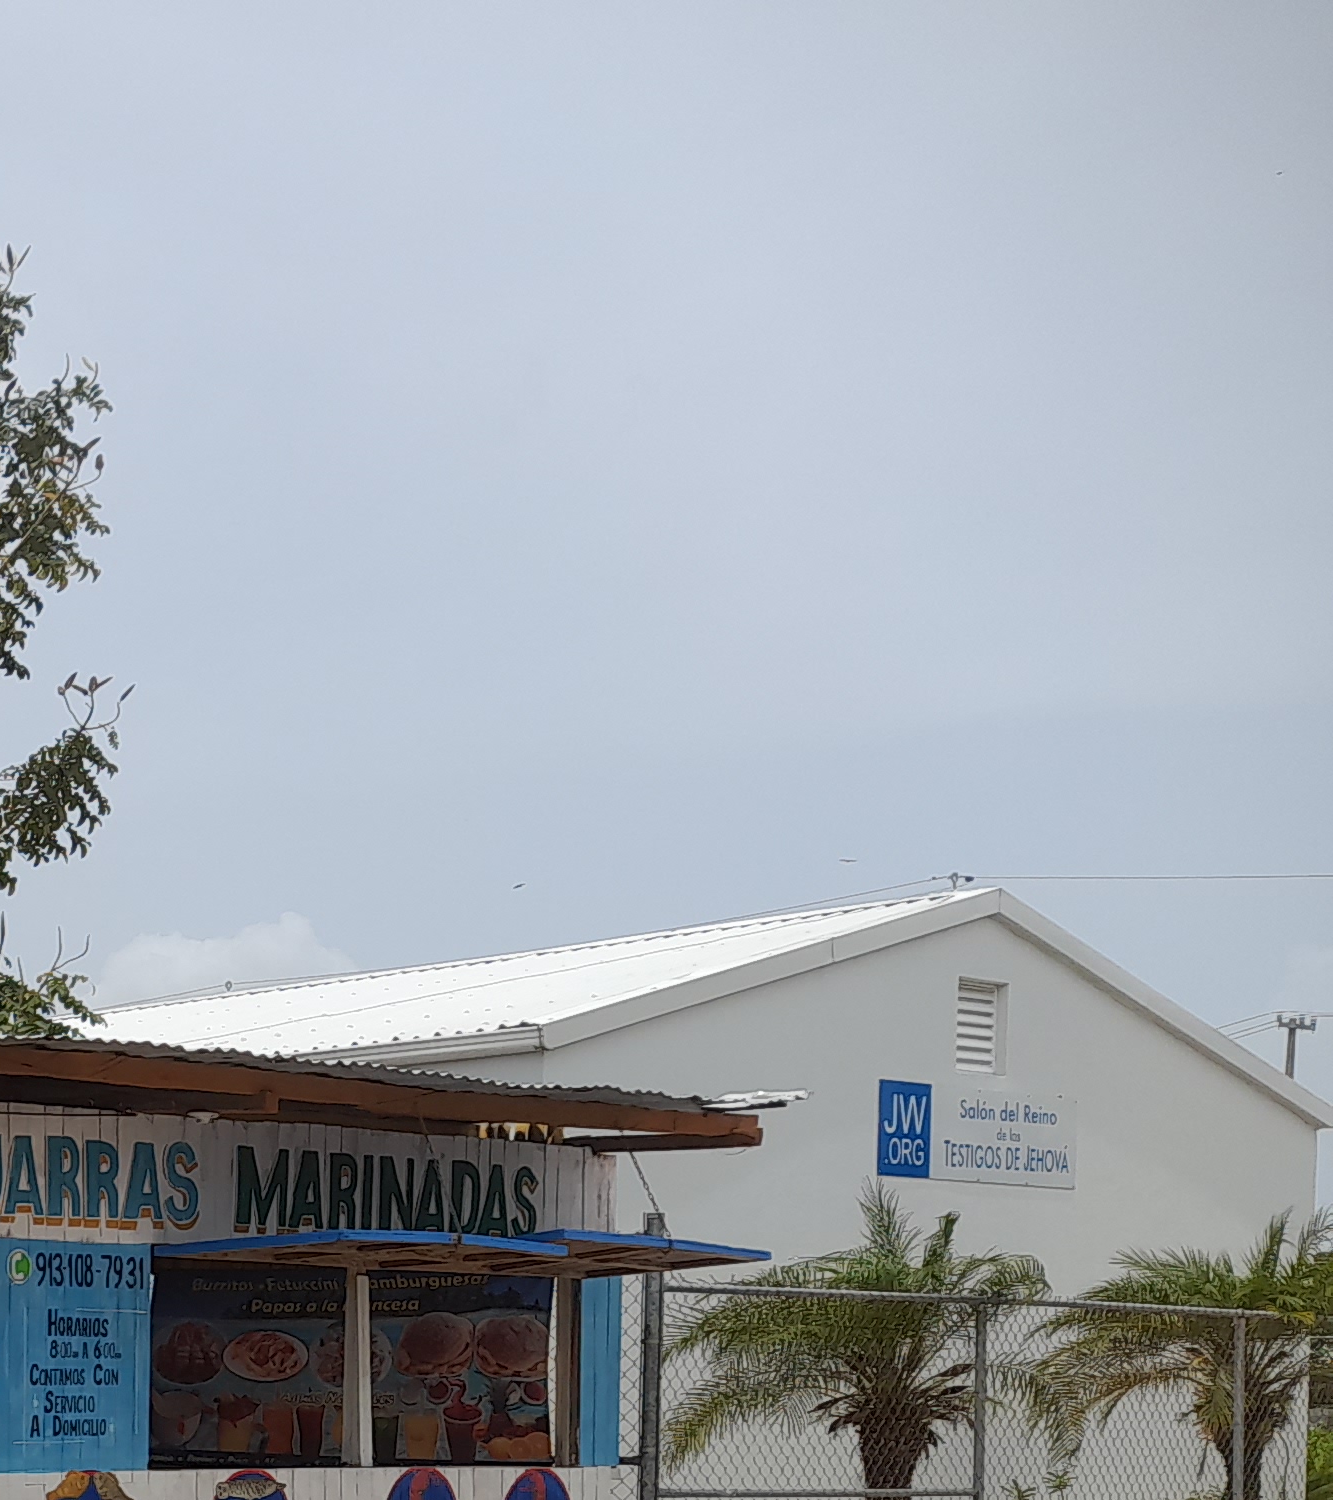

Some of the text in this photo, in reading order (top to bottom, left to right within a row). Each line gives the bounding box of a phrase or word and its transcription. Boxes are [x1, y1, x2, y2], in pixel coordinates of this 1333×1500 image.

[884, 1094, 927, 1135] JW
[960, 1099, 1058, 1126] Salón del Reino
[996, 1128, 1008, 1141] de
[884, 1138, 925, 1166] .ORG
[944, 1140, 1070, 1174] TESTIGOS DE JEHOVÁ
[233, 1144, 540, 1237] MARINADAS
[367, 1274, 489, 1290] amburguesas
[251, 1299, 301, 1316] Papas
[322, 1299, 338, 1313] la
[47, 1308, 109, 1337] HORARIOS
[30, 1415, 40, 1438] A
